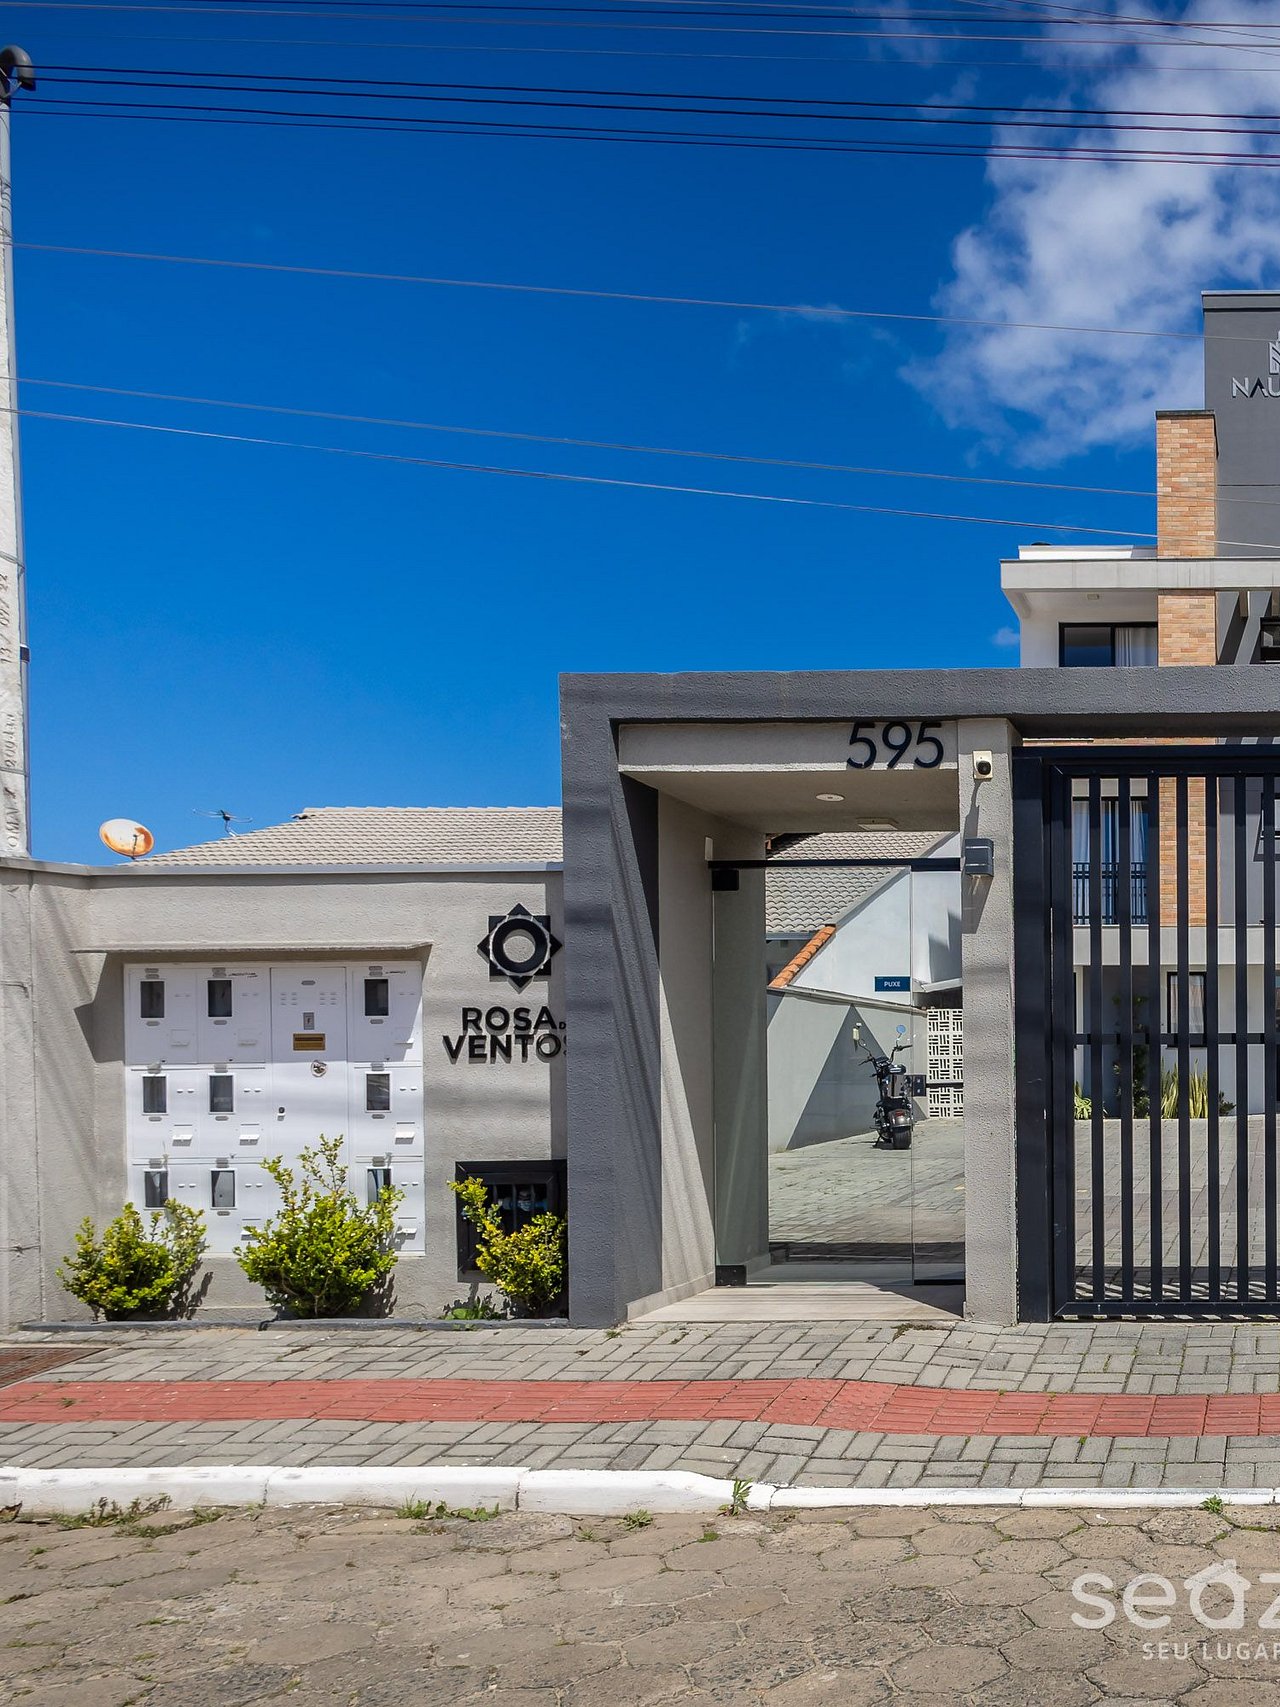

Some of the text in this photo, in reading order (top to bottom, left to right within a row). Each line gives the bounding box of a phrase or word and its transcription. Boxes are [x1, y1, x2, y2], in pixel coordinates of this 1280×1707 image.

[846, 721, 944, 769] 595
[462, 1005, 557, 1030] ROSA
[442, 1033, 567, 1059] VENTO
